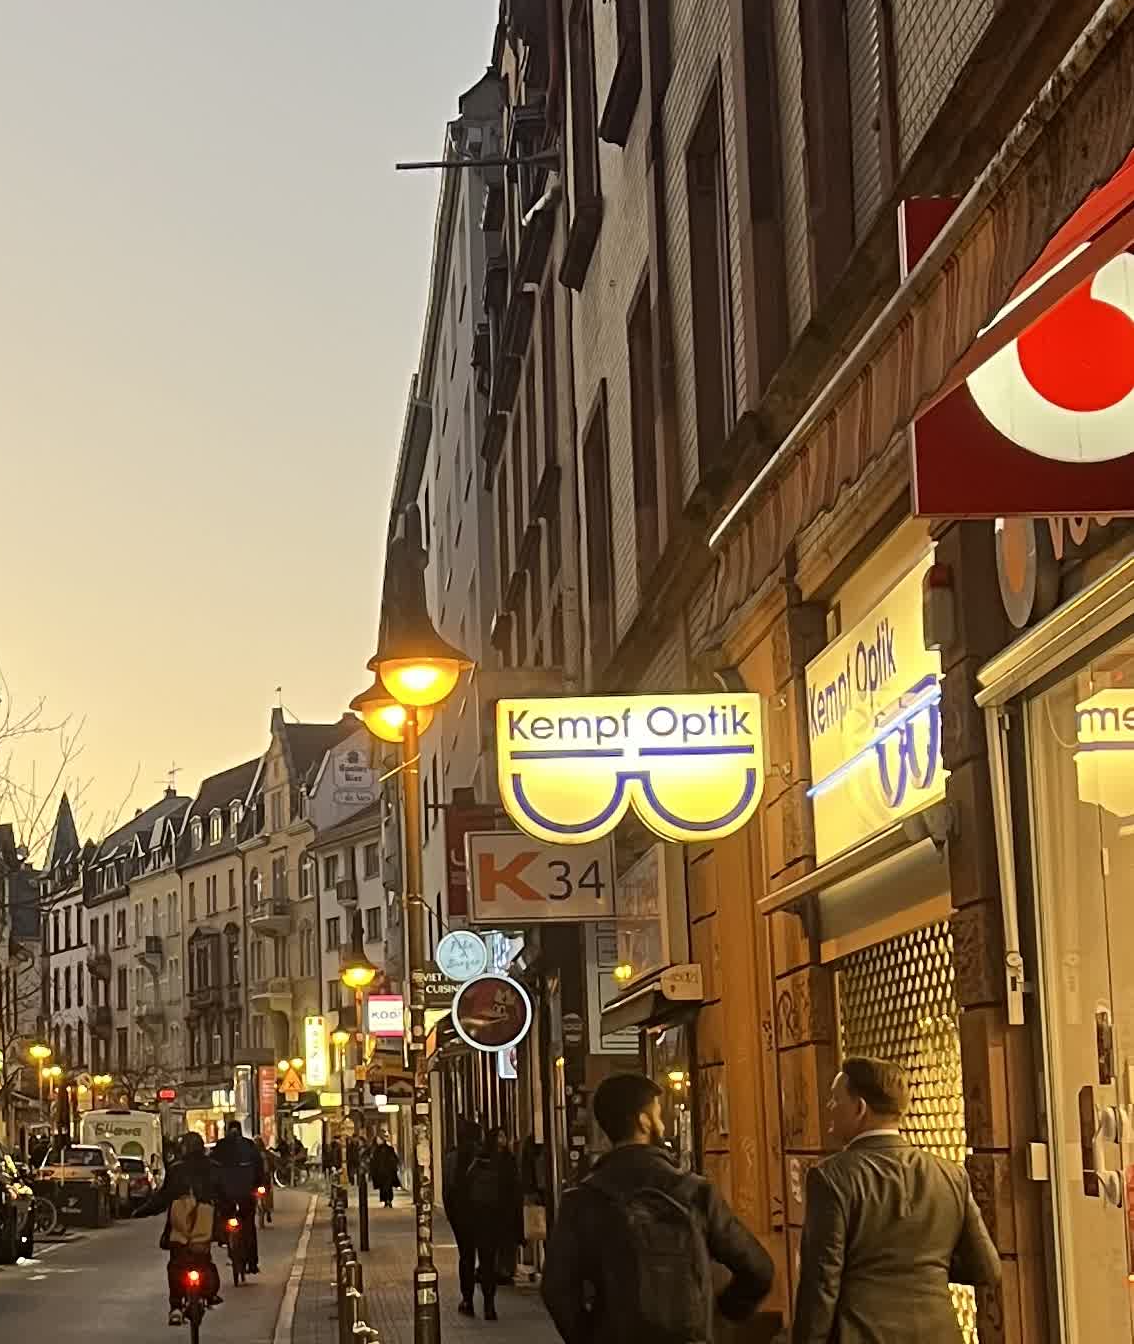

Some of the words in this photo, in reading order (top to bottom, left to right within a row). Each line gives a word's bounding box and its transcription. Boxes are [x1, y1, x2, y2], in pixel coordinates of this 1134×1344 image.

[808, 653, 852, 739] Kempf
[855, 617, 897, 710] Optik
[508, 708, 631, 746] Kempf
[646, 704, 753, 744] Optik
